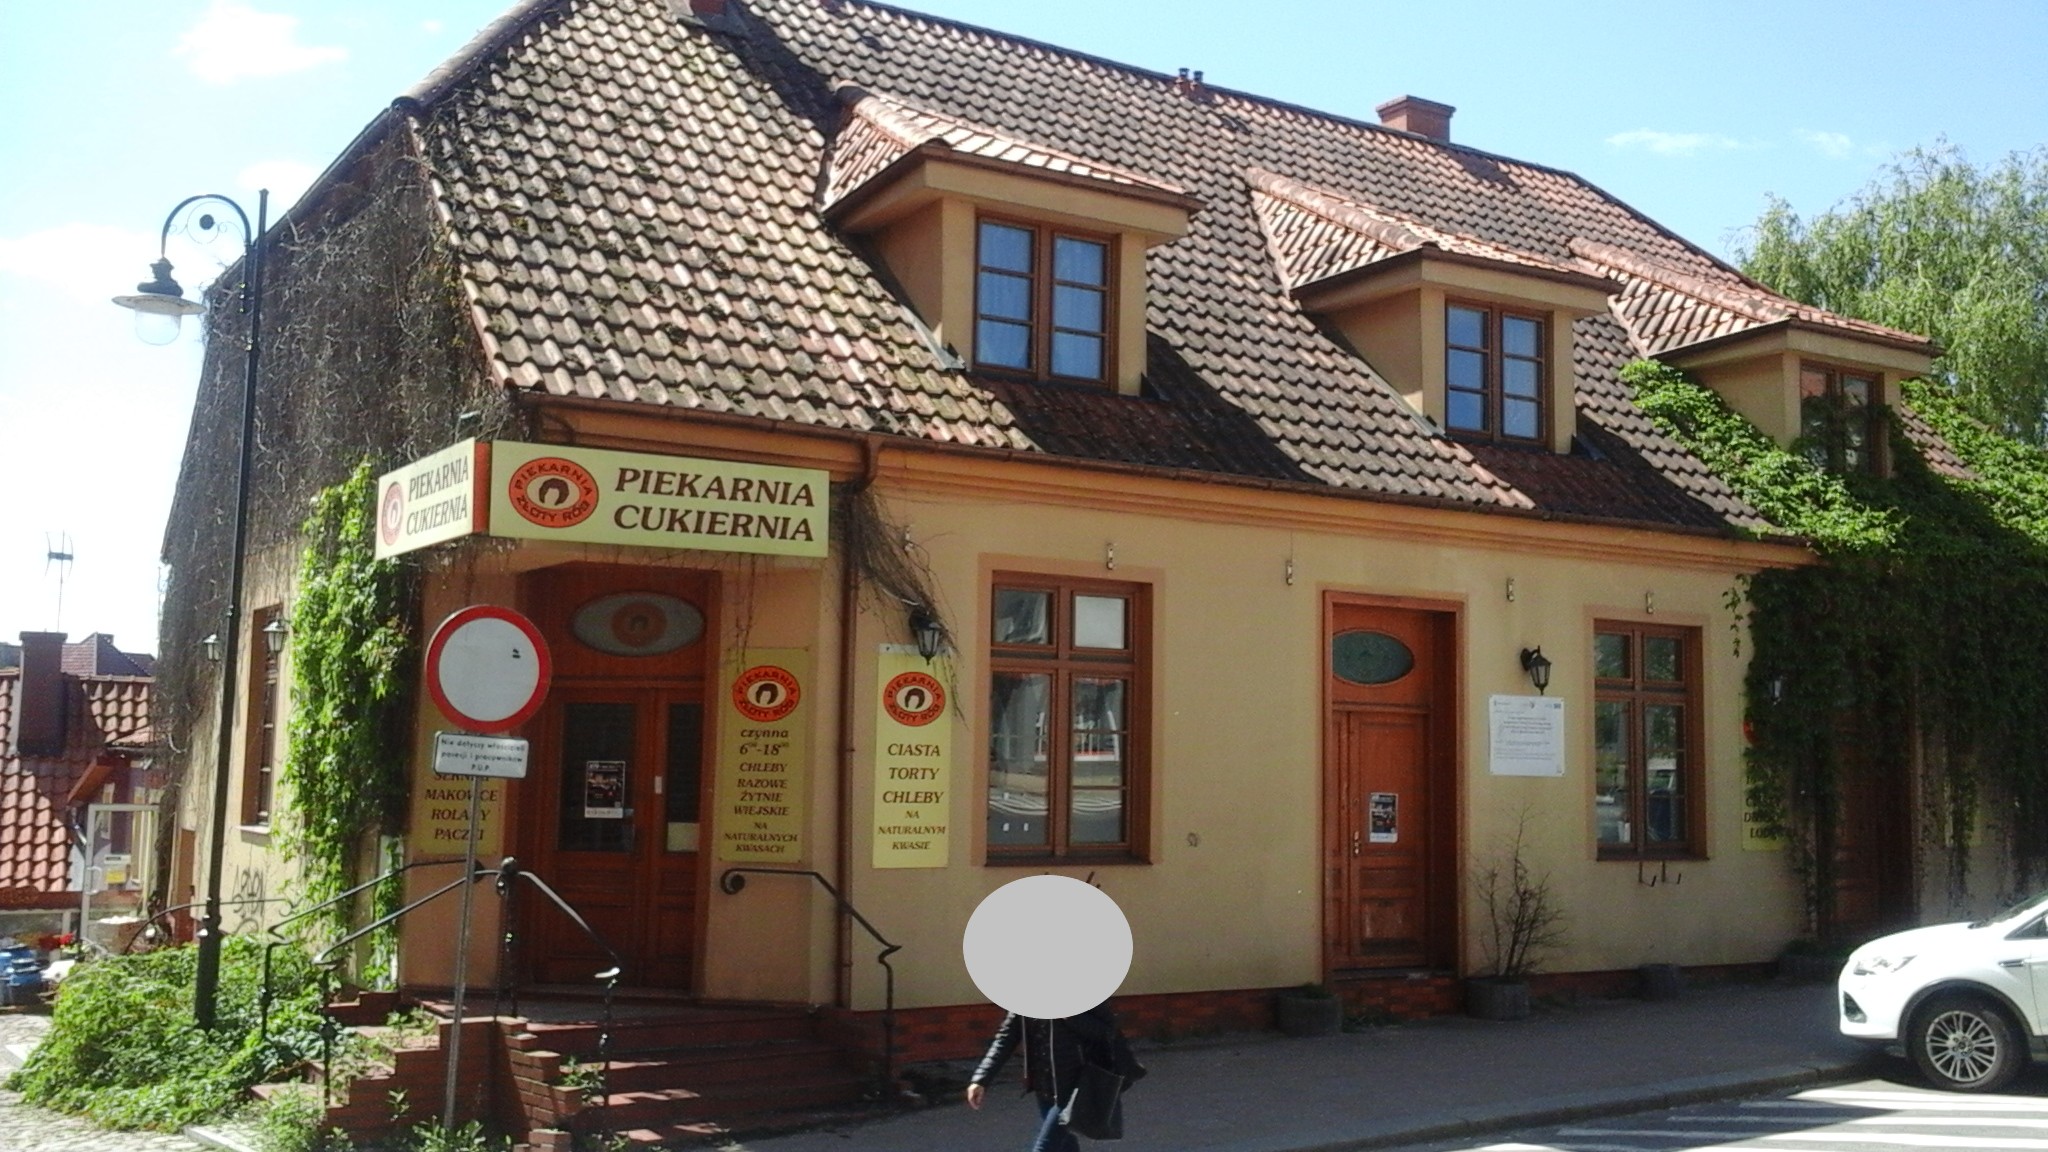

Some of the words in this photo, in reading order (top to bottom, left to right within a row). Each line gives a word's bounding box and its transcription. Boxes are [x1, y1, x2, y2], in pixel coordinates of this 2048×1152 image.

[408, 455, 469, 503] PIEKARNIA
[515, 463, 593, 496] PIEKARNIA
[614, 467, 815, 507] PIEKARNIA
[406, 493, 468, 536] CUKIERNIA
[614, 504, 814, 542] CUKIERNIA
[740, 728, 789, 740] czynna
[887, 743, 941, 757] CIASTA
[739, 762, 788, 773] CHLEBY
[889, 767, 940, 780] TORTY
[737, 779, 788, 789] RAZOWE
[424, 789, 499, 802] MAKOCE
[882, 791, 945, 804] CHLEBY
[431, 809, 491, 821] ROLAY
[734, 806, 790, 816] WIEJSKIE
[905, 810, 920, 819] NA
[754, 822, 768, 830] NA
[878, 826, 946, 835] NATURALNYM
[434, 828, 484, 842] PĄCZI
[892, 841, 931, 850] KWASIE
